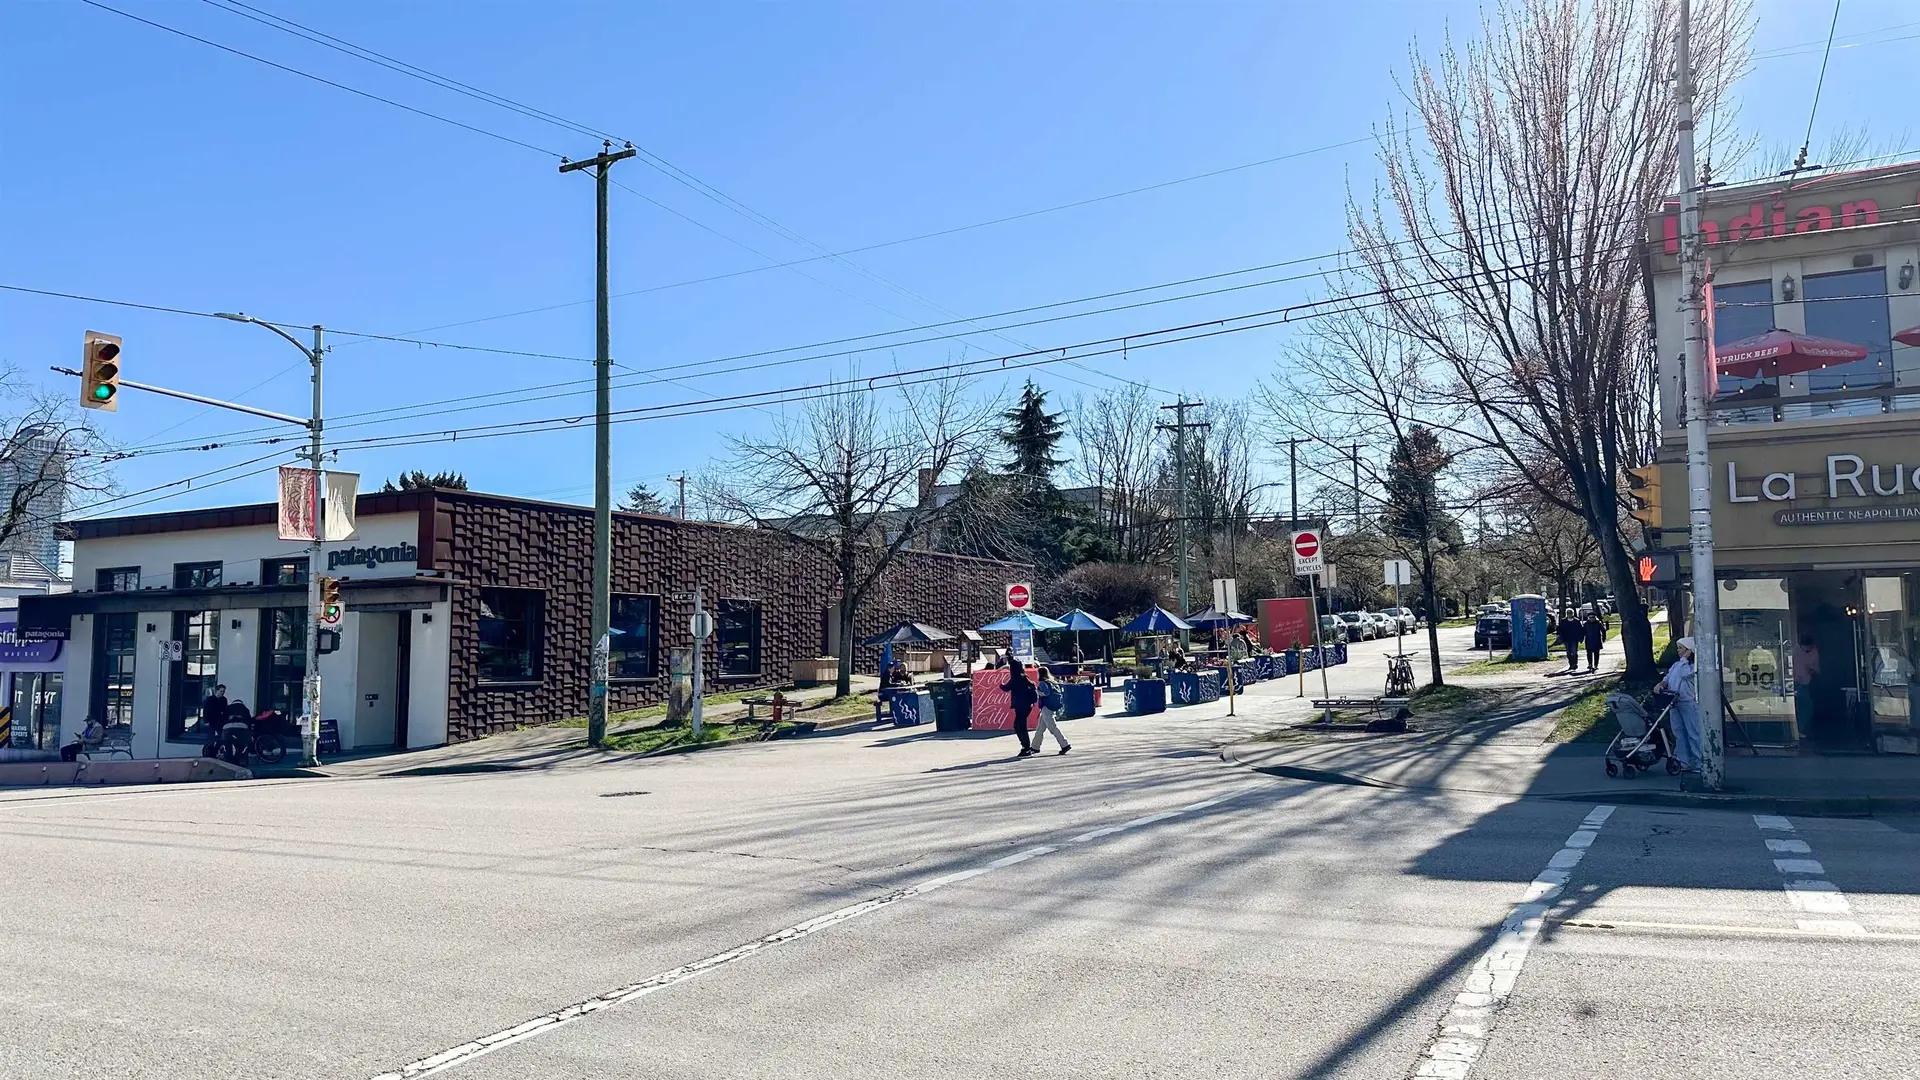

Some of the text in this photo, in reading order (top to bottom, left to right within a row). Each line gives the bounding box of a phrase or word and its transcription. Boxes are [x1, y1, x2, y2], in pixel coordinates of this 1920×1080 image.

[1663, 198, 1880, 256] Indian
[1722, 353, 1752, 363] TRUCK
[1754, 347, 1779, 358] BEER
[1727, 454, 1920, 503] La Ru
[1780, 508, 1920, 523] AUTHENTIC NEAPOLITAN
[327, 541, 417, 571] patagonia
[1298, 556, 1318, 565] EXCEPT
[1296, 564, 1322, 573] BICYCLES
[25, 630, 65, 639] patagonia
[974, 670, 1011, 690] Love
[975, 705, 1010, 730] City
